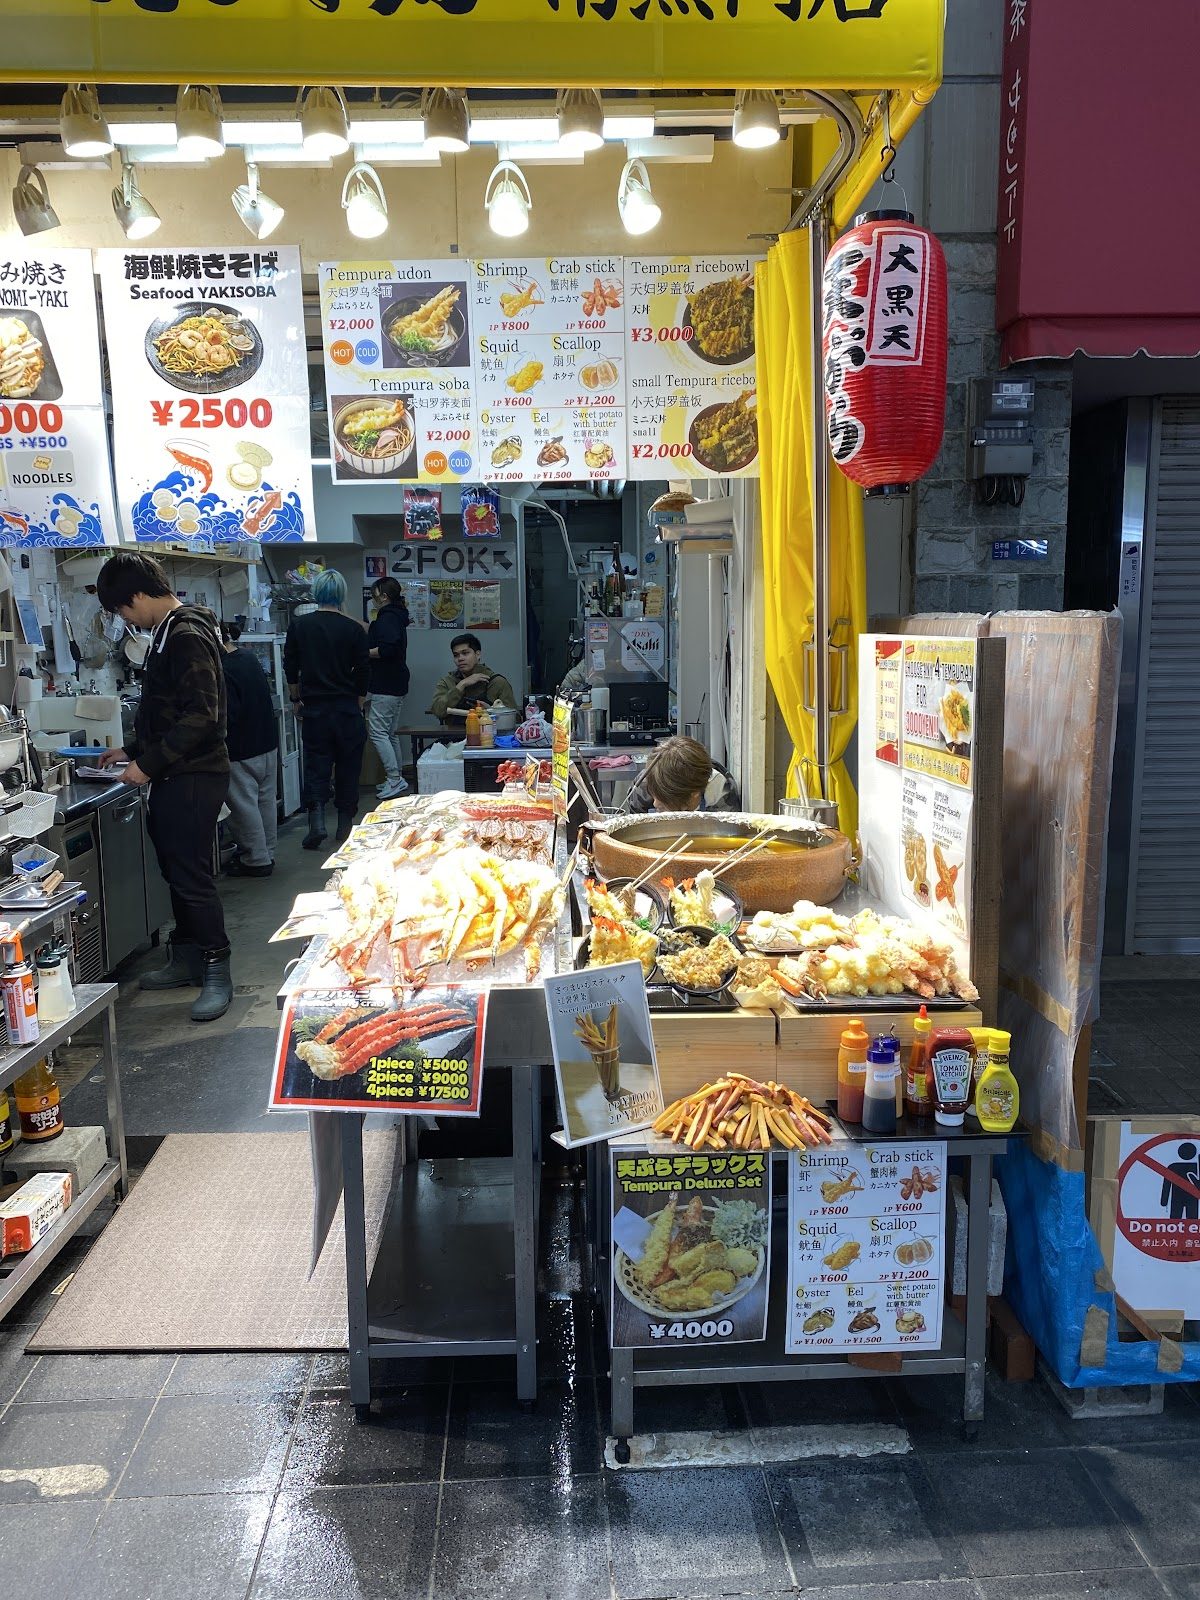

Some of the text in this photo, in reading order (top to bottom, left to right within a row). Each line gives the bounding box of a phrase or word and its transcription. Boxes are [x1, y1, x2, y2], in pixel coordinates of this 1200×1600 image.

[124, 252, 279, 280] 海鮮焼きそば
[477, 263, 528, 277] Shrimp
[550, 260, 616, 274] Crab stick
[631, 260, 750, 275] Tempura ricebowl
[0, 261, 67, 286] み焼き
[326, 267, 432, 282] Tempura udon
[477, 280, 489, 292] 虾
[550, 279, 579, 291] 蟹肉棒
[630, 281, 695, 296] 天妇罗盖饭
[130, 284, 277, 300] Seafood YAKISOBA
[327, 286, 392, 298] 天妇罗乌冬面
[879, 243, 919, 350] 大黒天
[330, 301, 373, 310] 天ぷらうどん
[632, 304, 650, 315] 天丼
[329, 319, 374, 331] ¥2,000
[501, 321, 529, 331] ¥800
[578, 320, 606, 330] ¥600
[631, 326, 694, 344] ¥3,000
[480, 340, 519, 354] Squid
[553, 336, 601, 351] Scallop
[334, 348, 377, 357] HOT COLD
[480, 358, 504, 371] 鱿鱼
[553, 355, 576, 368] 扇贝
[553, 372, 575, 380] ホタテ
[632, 375, 661, 388] small
[665, 375, 718, 389] Tempura
[369, 377, 469, 393] Tempura soba
[407, 397, 471, 409] 天妇罗荞麦面
[505, 397, 532, 406] ¥600
[577, 395, 615, 406] ¥1,200
[631, 395, 702, 409] 小天妇罗盖饭
[150, 398, 273, 428] ¥2500
[433, 413, 470, 421] 天ぷらそば
[481, 413, 516, 425] Oyster
[533, 412, 550, 423] Eel
[572, 410, 623, 420] Sweet potato
[573, 419, 617, 428] with butter
[632, 414, 667, 425] ミニ天丼
[19, 435, 67, 448] +¥500
[426, 430, 470, 442] ¥2,000
[631, 443, 693, 460] ¥2,000
[427, 458, 469, 467] HOT COLD
[12, 472, 73, 485] NOODLES
[494, 472, 523, 480] ¥1,000
[543, 471, 572, 479] ¥1,500
[589, 470, 610, 478] ¥600
[626, 637, 660, 651] Asahi
[934, 656, 940, 678] 4
[368, 1056, 468, 1072] 1piece ¥5000
[367, 1070, 468, 1085] 2piece ¥9000
[366, 1084, 469, 1099] 4piece ¥17500
[30, 1104, 59, 1123] お好み
[36, 1117, 58, 1131] ソース
[800, 1154, 849, 1167] Shrimp
[870, 1149, 934, 1163] Crab stick
[616, 1154, 766, 1178] 天ぷらデラックス
[799, 1170, 811, 1181] 虾
[870, 1167, 898, 1178] 蟹肉棒
[621, 1176, 762, 1194] Tempura Deluxe Set
[821, 1206, 849, 1215] ¥800
[895, 1202, 922, 1211] ¥600
[799, 1222, 837, 1237] Squid
[871, 1218, 917, 1232] Scallop
[1130, 1220, 1200, 1233] Do not e
[799, 1239, 821, 1251] 鱿鱼
[870, 1235, 892, 1246] 扇贝
[1142, 1239, 1178, 1247] 禁止入内
[820, 1273, 848, 1282] ¥600
[892, 1270, 929, 1280] ¥1,200
[796, 1288, 830, 1299] Oyster
[848, 1287, 864, 1297] Eel
[887, 1283, 936, 1292] Sweet potato
[650, 1320, 733, 1338] ¥4000
